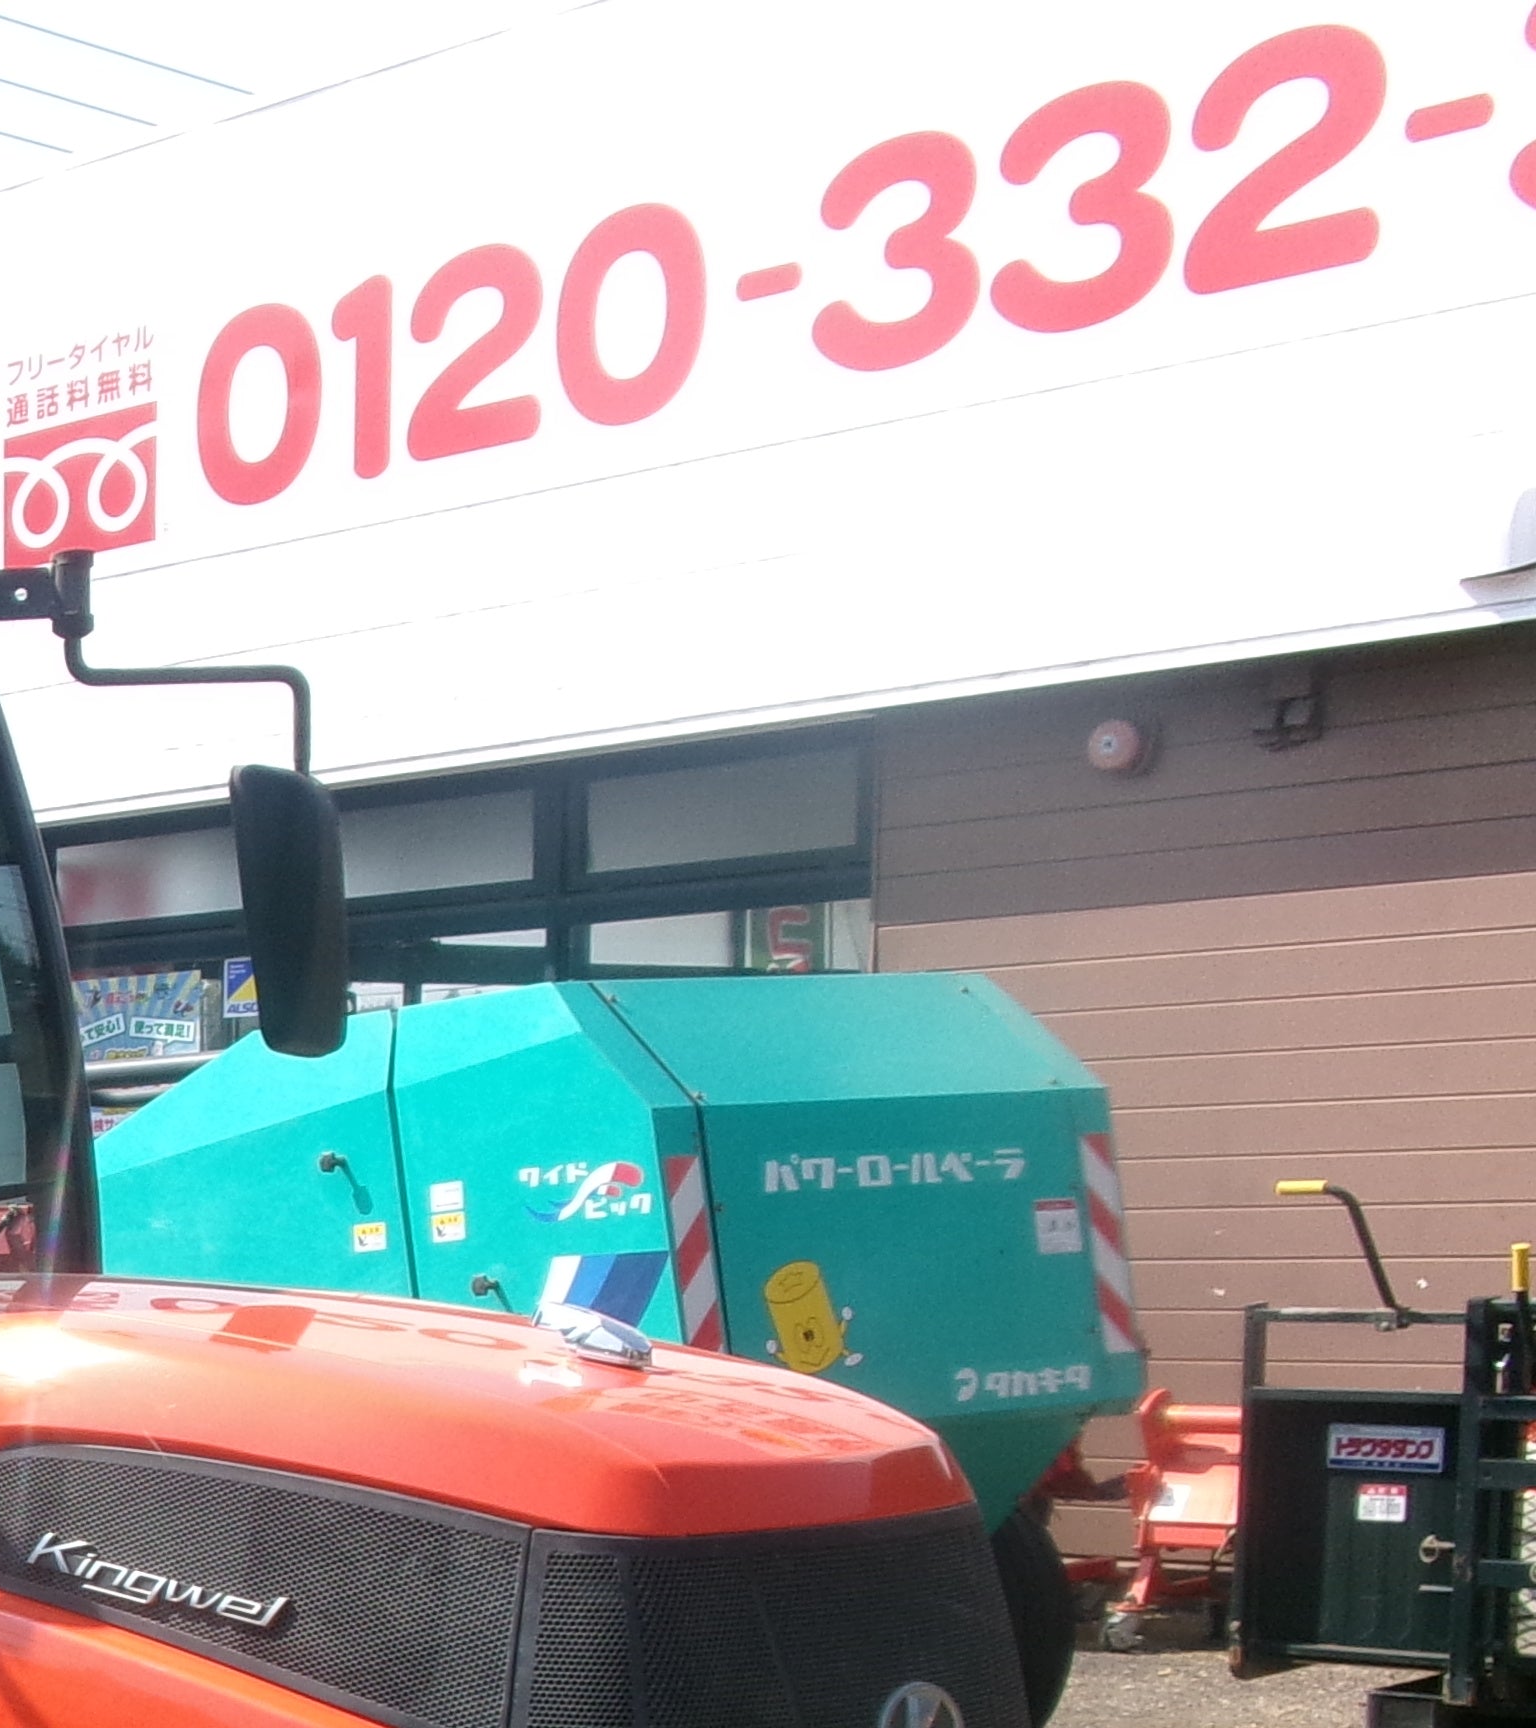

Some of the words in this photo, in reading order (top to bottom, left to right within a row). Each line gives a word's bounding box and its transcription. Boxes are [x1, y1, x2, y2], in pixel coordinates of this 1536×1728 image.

[196, 2, 1536, 508] 0120-332-
[6, 359, 153, 429] 通話料無料
[518, 1161, 590, 1188] ワイド
[764, 1147, 1026, 1194] パワーロールベーラ
[985, 1364, 1091, 1398] タカキタ
[27, 1532, 290, 1627] Kingwel
